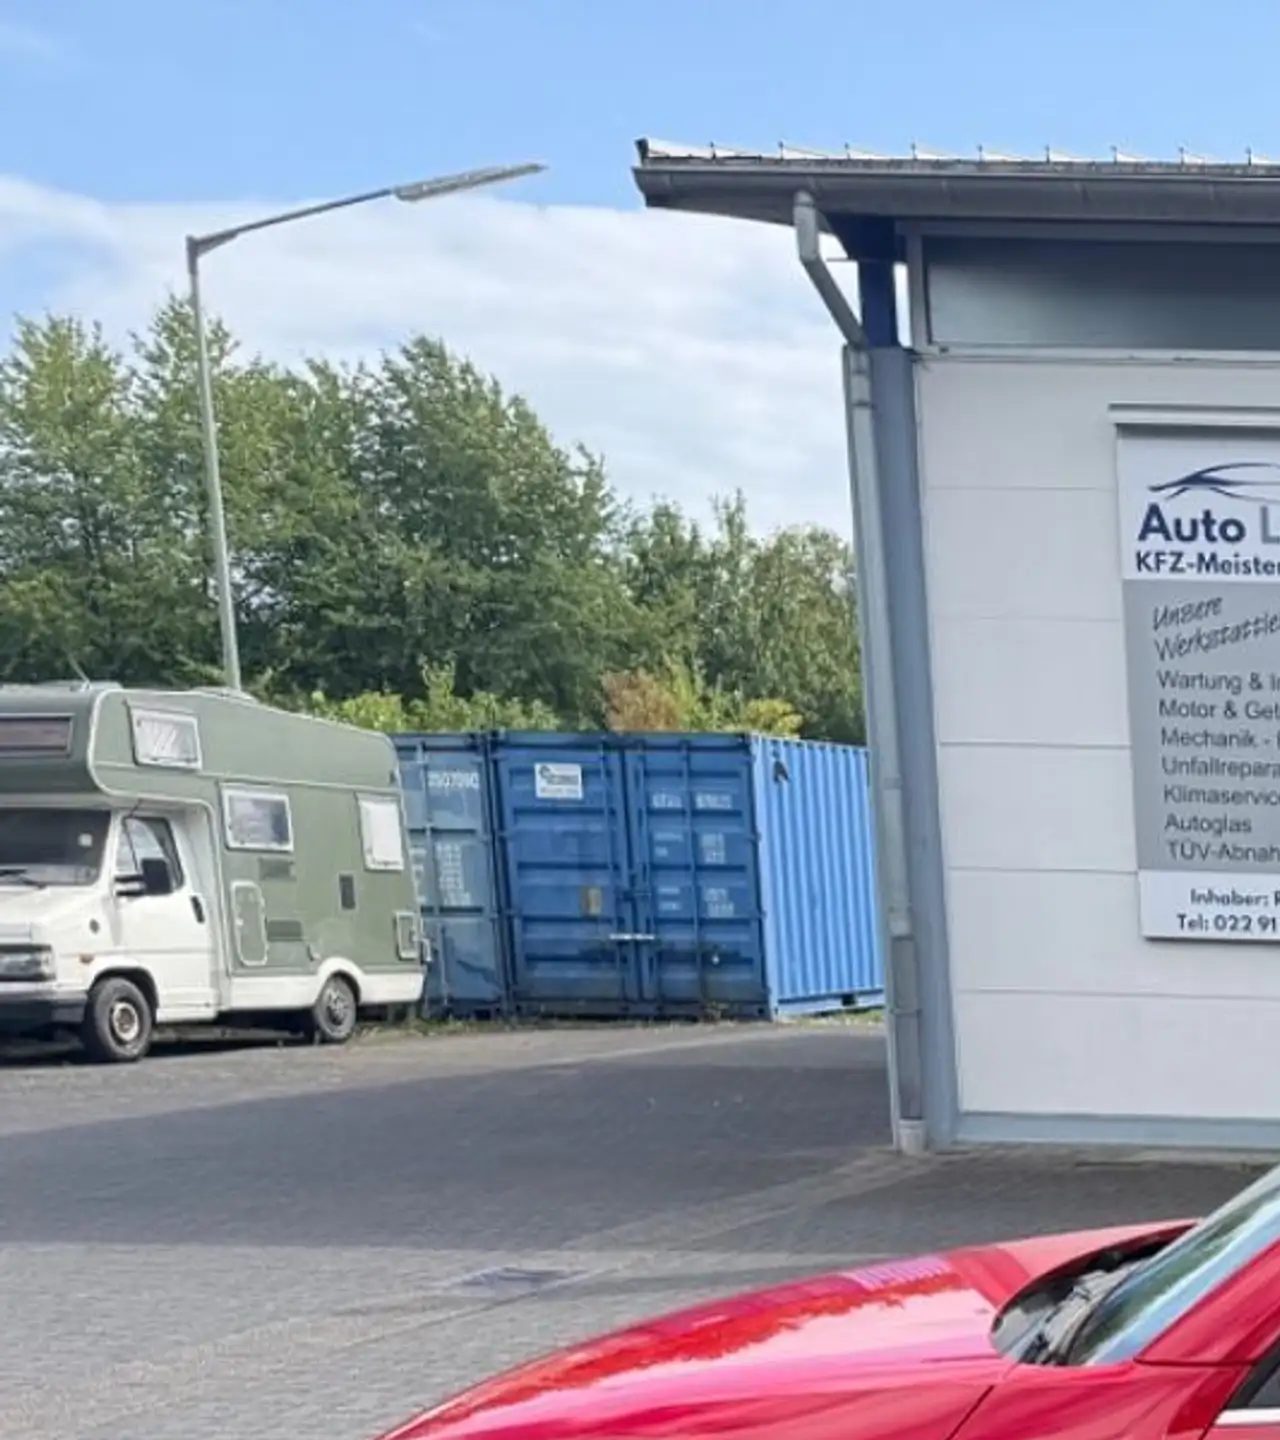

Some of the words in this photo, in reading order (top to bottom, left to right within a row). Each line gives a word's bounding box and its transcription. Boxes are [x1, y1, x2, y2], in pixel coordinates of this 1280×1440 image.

[1138, 503, 1246, 544] Auto
[1153, 597, 1223, 631] Unsere
[1157, 670, 1242, 695] Wartung
[1249, 673, 1263, 690] &
[1158, 699, 1216, 719] Motor
[1224, 700, 1237, 719] &
[1161, 727, 1255, 748] Mechanik
[1165, 813, 1252, 835] Autoglas
[1190, 889, 1269, 907] Inhaber:
[1177, 914, 1209, 931] Tel:
[1214, 915, 1252, 931] 022
[1256, 916, 1277, 933] 91
